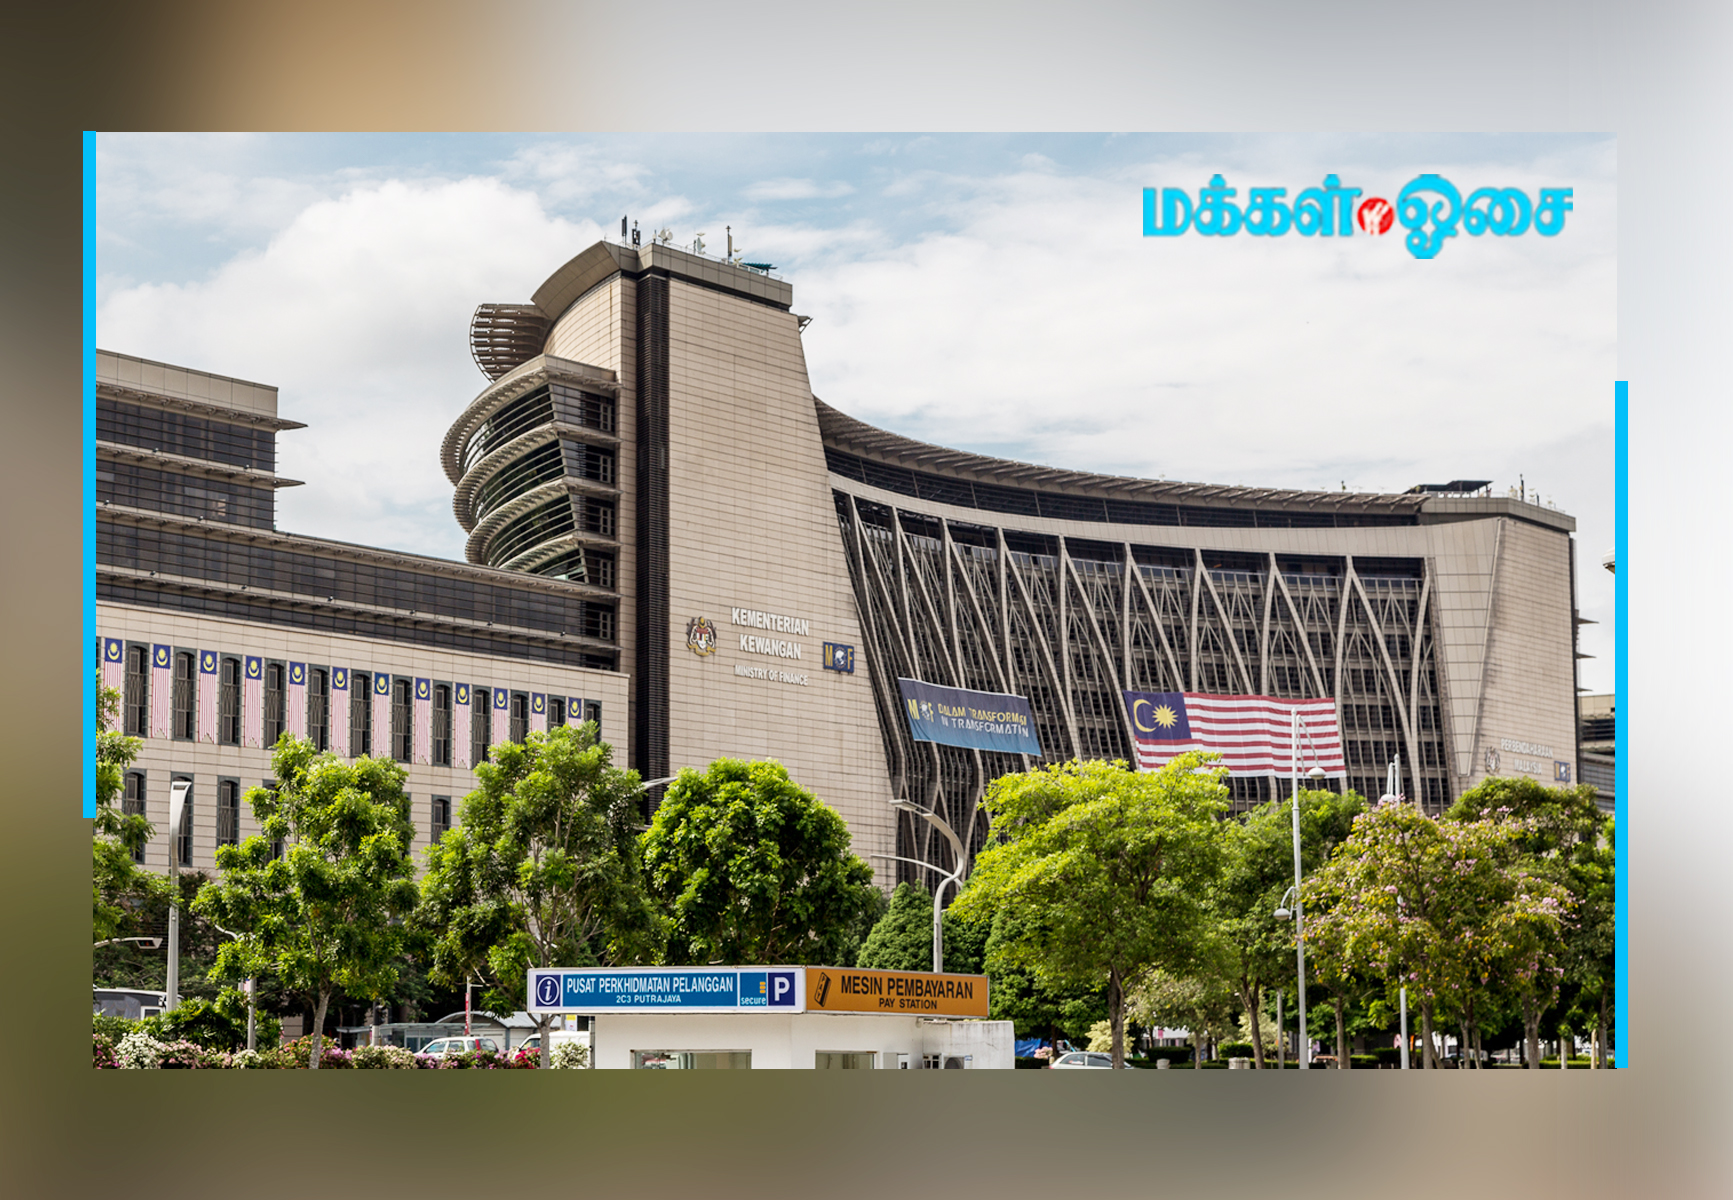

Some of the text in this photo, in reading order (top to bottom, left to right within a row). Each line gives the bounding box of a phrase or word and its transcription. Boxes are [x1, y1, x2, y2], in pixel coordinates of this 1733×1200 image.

[731, 607, 809, 637] KEMENTERIAN
[739, 633, 801, 660] KEWANGAN
[734, 664, 809, 686] MINISTRY OF FINANCE
[951, 718, 1029, 738] TRANSFORMATIN
[566, 976, 733, 994] PUSAT PERKHIDMATAN PELANGGAN
[774, 976, 790, 1002] P
[841, 975, 973, 999] MESIN PEMBAYARAN
[616, 994, 682, 1004] 2C3 PUTRAJAYA
[740, 996, 767, 1005] secure
[879, 998, 938, 1009] PAY STATION
